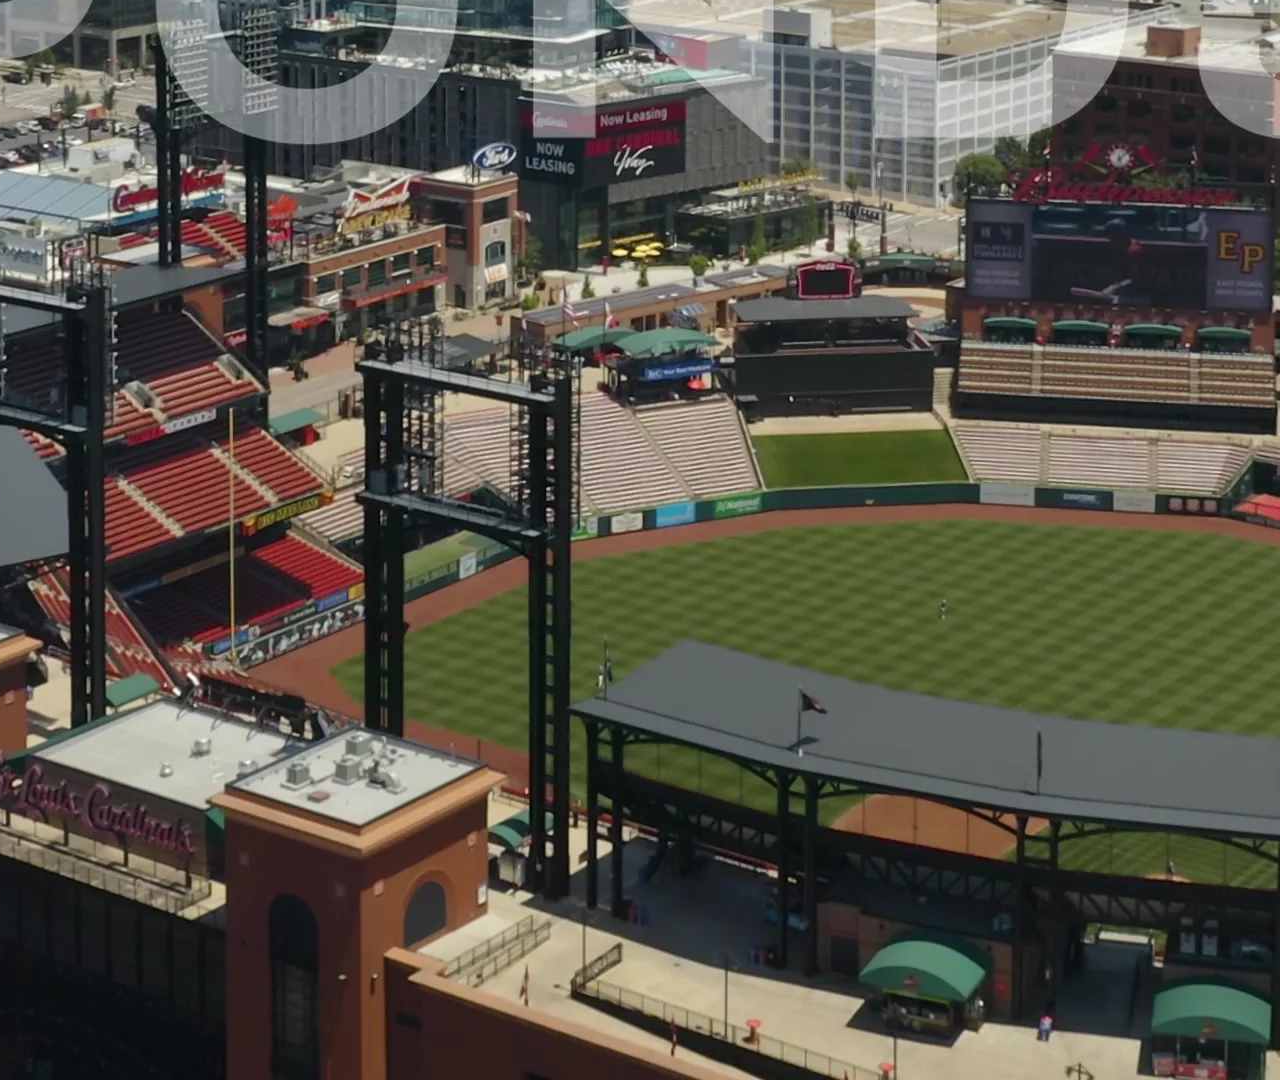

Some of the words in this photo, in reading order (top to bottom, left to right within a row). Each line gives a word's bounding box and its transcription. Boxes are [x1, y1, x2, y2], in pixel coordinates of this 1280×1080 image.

[600, 114, 624, 128] Now
[626, 107, 668, 124] Leasing
[482, 146, 510, 167] Ford
[537, 142, 564, 156] NOW
[526, 156, 575, 174] LEASING
[16, 764, 82, 823] Louis
[84, 783, 195, 855] Cardinals
